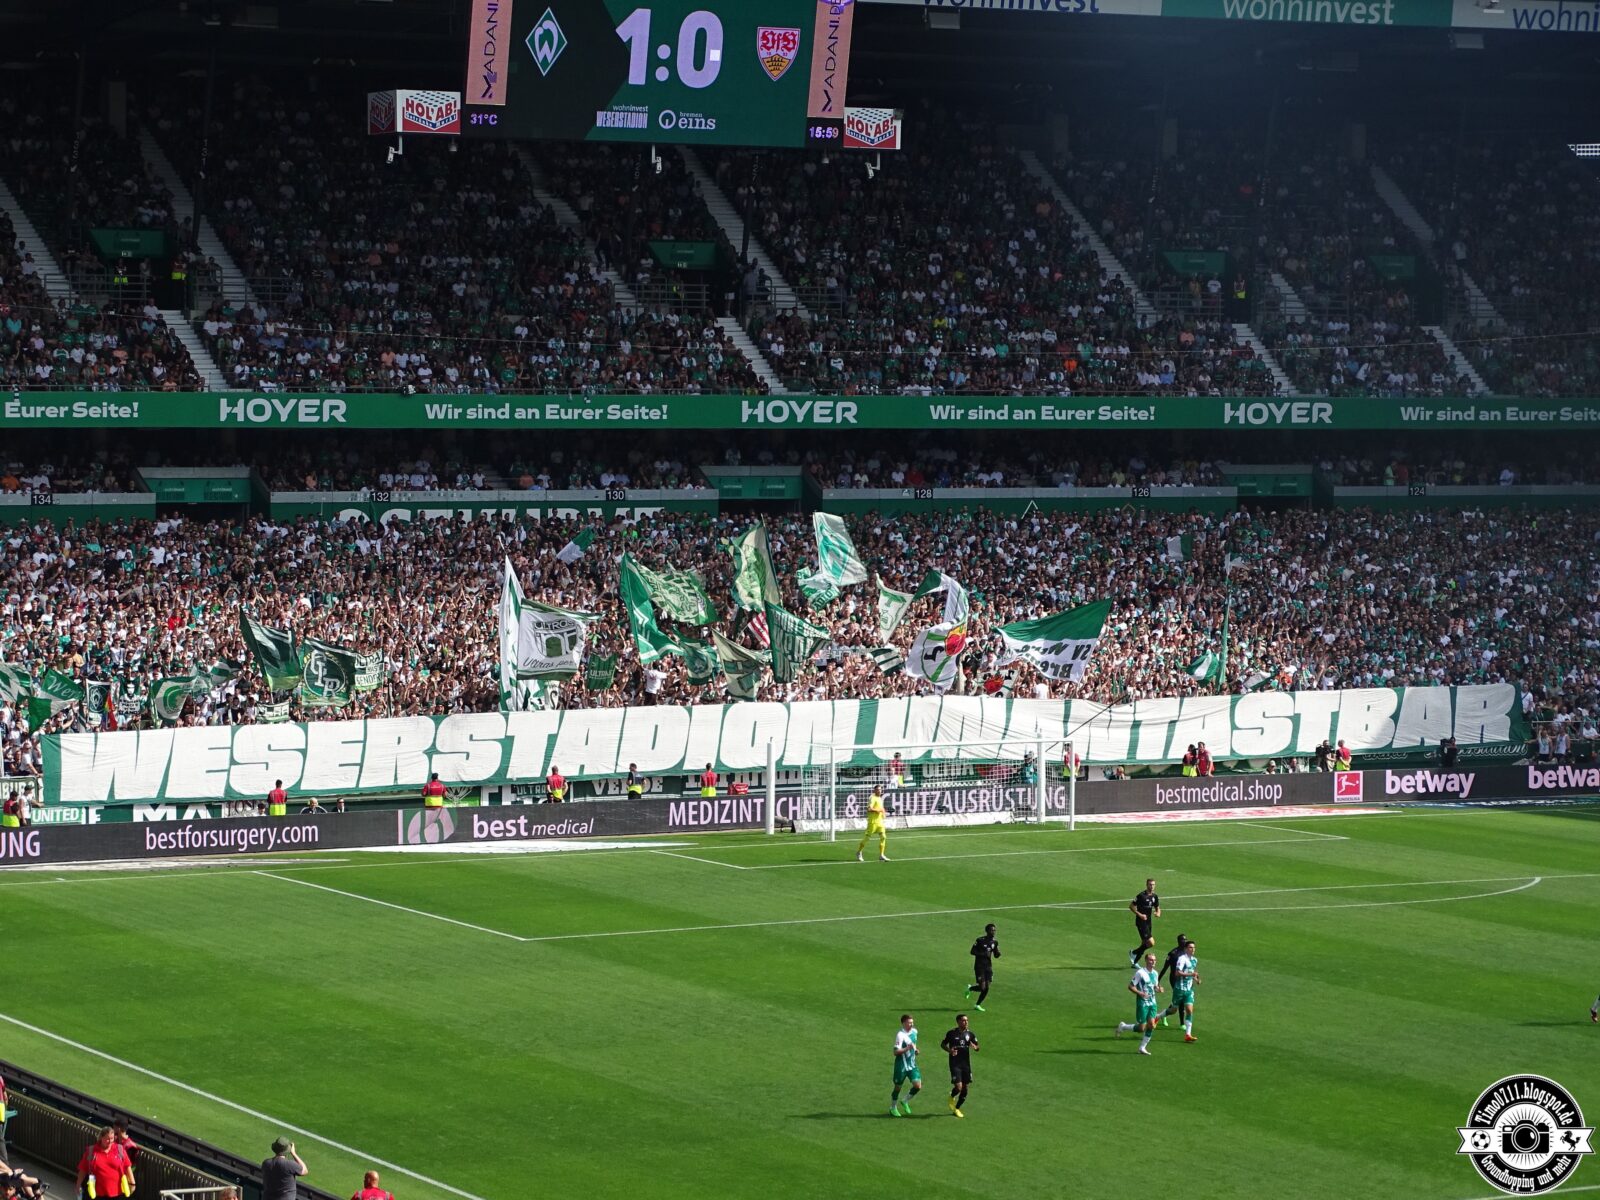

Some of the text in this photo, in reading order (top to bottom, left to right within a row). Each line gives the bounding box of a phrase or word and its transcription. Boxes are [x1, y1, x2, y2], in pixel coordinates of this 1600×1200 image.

[615, 8, 723, 88] 1:0
[470, 113, 498, 125] 31°C
[596, 111, 648, 129] WESERSTADION
[678, 118, 716, 130] eins
[809, 127, 839, 139] 15:59
[5, 401, 139, 418] Eurer Seite!
[219, 398, 346, 422] HOYER
[425, 404, 668, 420] Wir sind an Eurer Seite!
[741, 400, 858, 424] HOYER
[929, 404, 1155, 421] Wir sind an Eurer Seite!
[1224, 402, 1333, 424] HOYER
[1400, 406, 1600, 421] Wir sind an Eurer Seit
[32, 494, 51, 505] 134
[371, 492, 389, 502] 132
[607, 490, 625, 501] 130
[915, 489, 932, 499] 128
[1133, 488, 1149, 497] 126
[1409, 487, 1425, 496] 124
[60, 683, 1516, 802] WESERSTADION UNANTASTBAR
[1385, 769, 1475, 799] betway
[1528, 765, 1600, 794] betwa
[1155, 780, 1283, 805] bestmedical.shop
[668, 794, 832, 826] MEDIZINTCHNIK
[879, 784, 1067, 816] CHUTZAUSRÜSTUNG
[32, 808, 79, 822] UNITED
[473, 814, 595, 839] best medical
[145, 825, 319, 851] bestforsurgery.com
